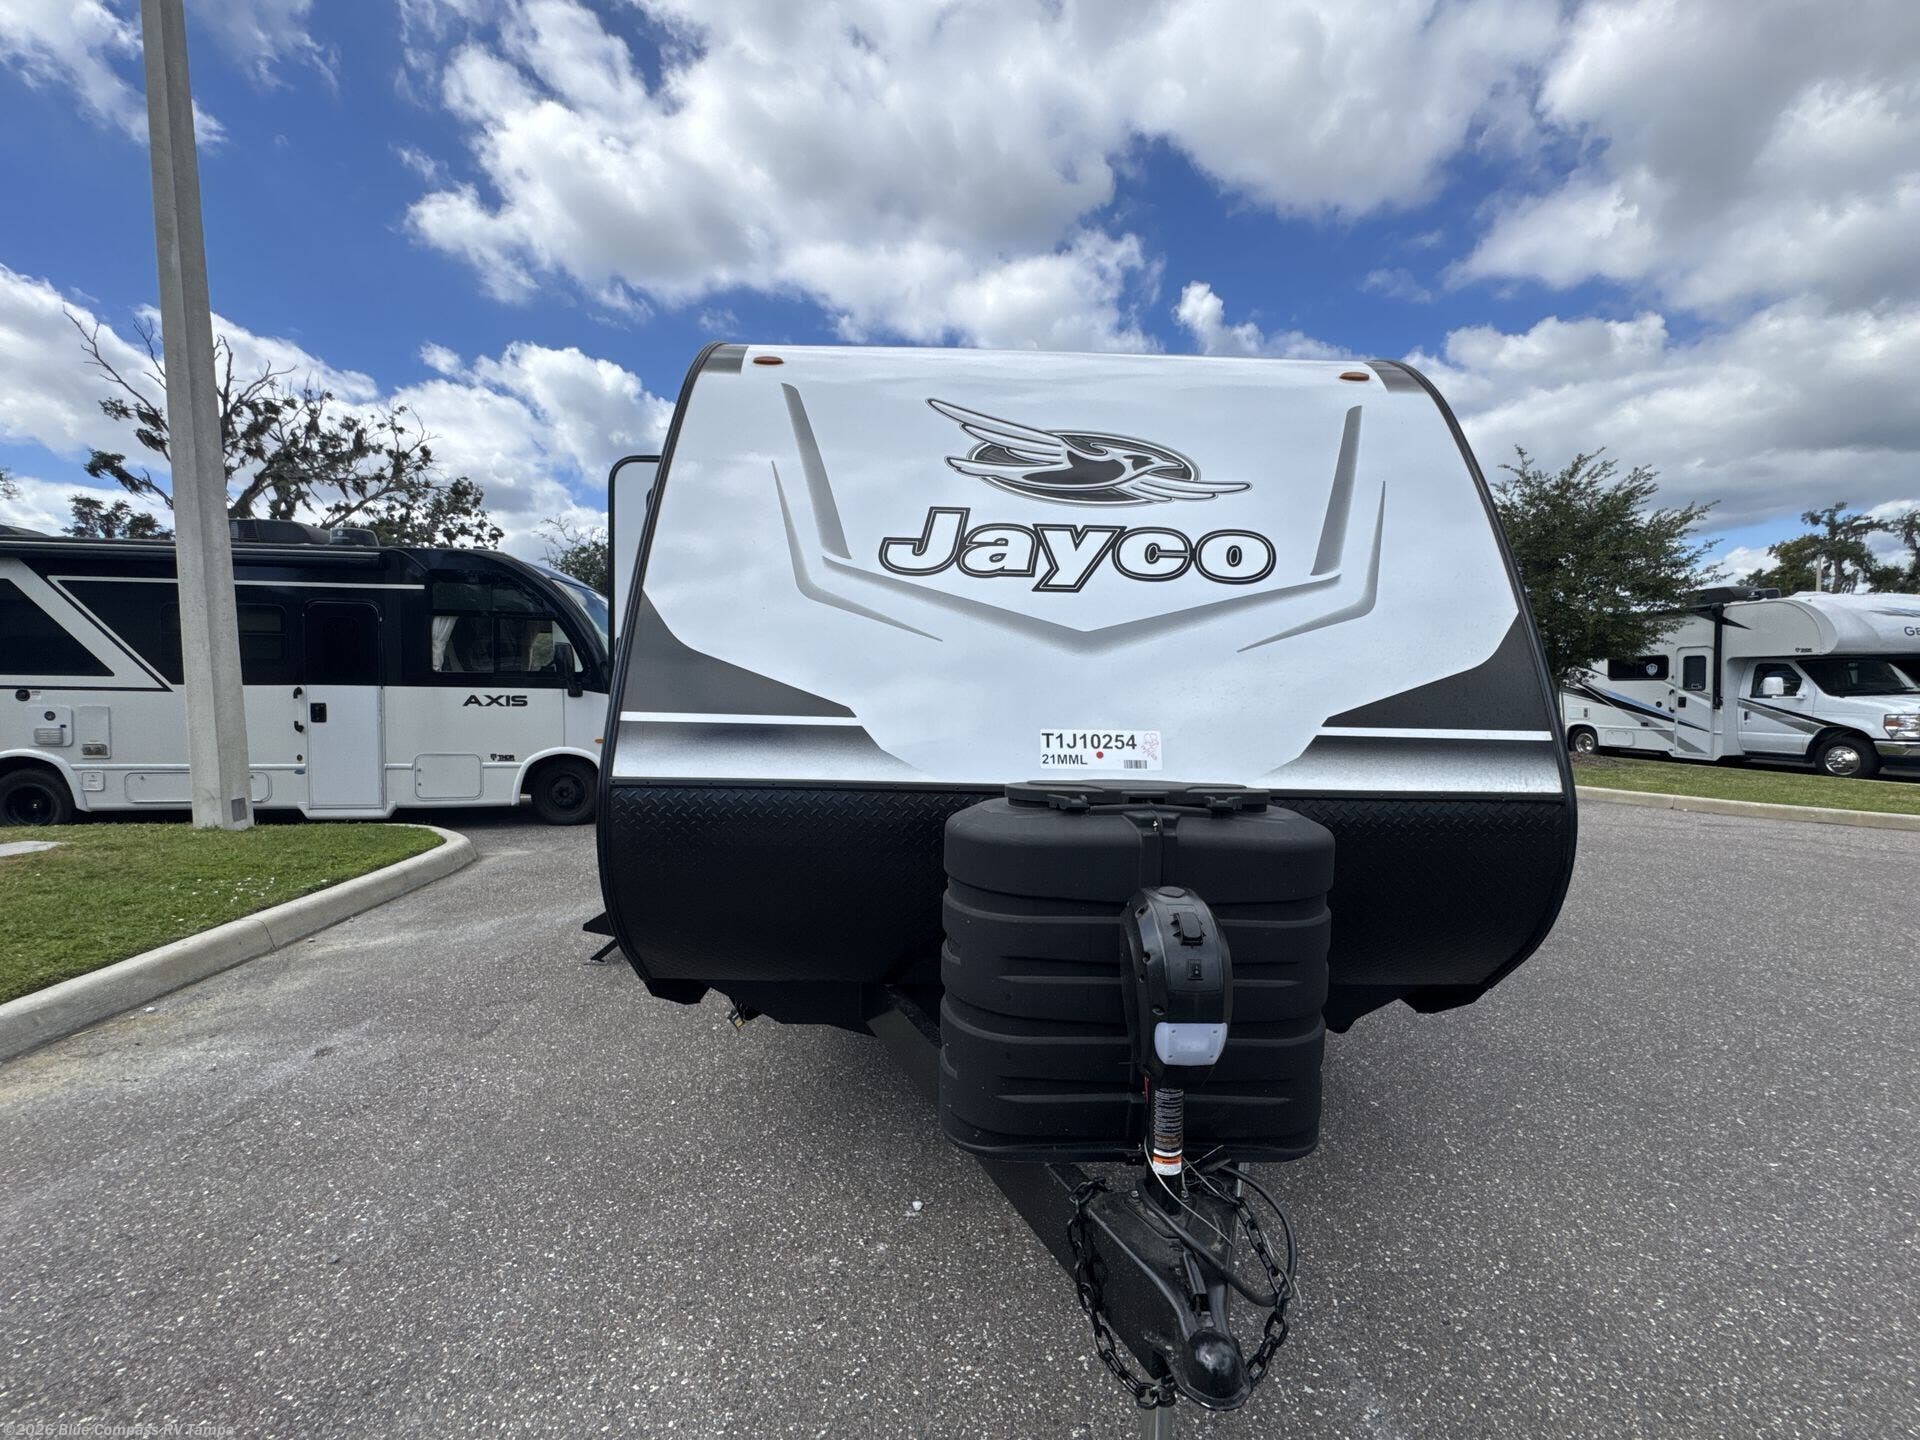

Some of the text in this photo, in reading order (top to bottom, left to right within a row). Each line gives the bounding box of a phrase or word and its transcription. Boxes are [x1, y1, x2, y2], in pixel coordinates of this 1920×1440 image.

[878, 506, 1277, 593] Jayco
[462, 694, 528, 707] AXIS
[1041, 733, 1137, 749] T1J10254
[1041, 754, 1088, 765] 21MML
